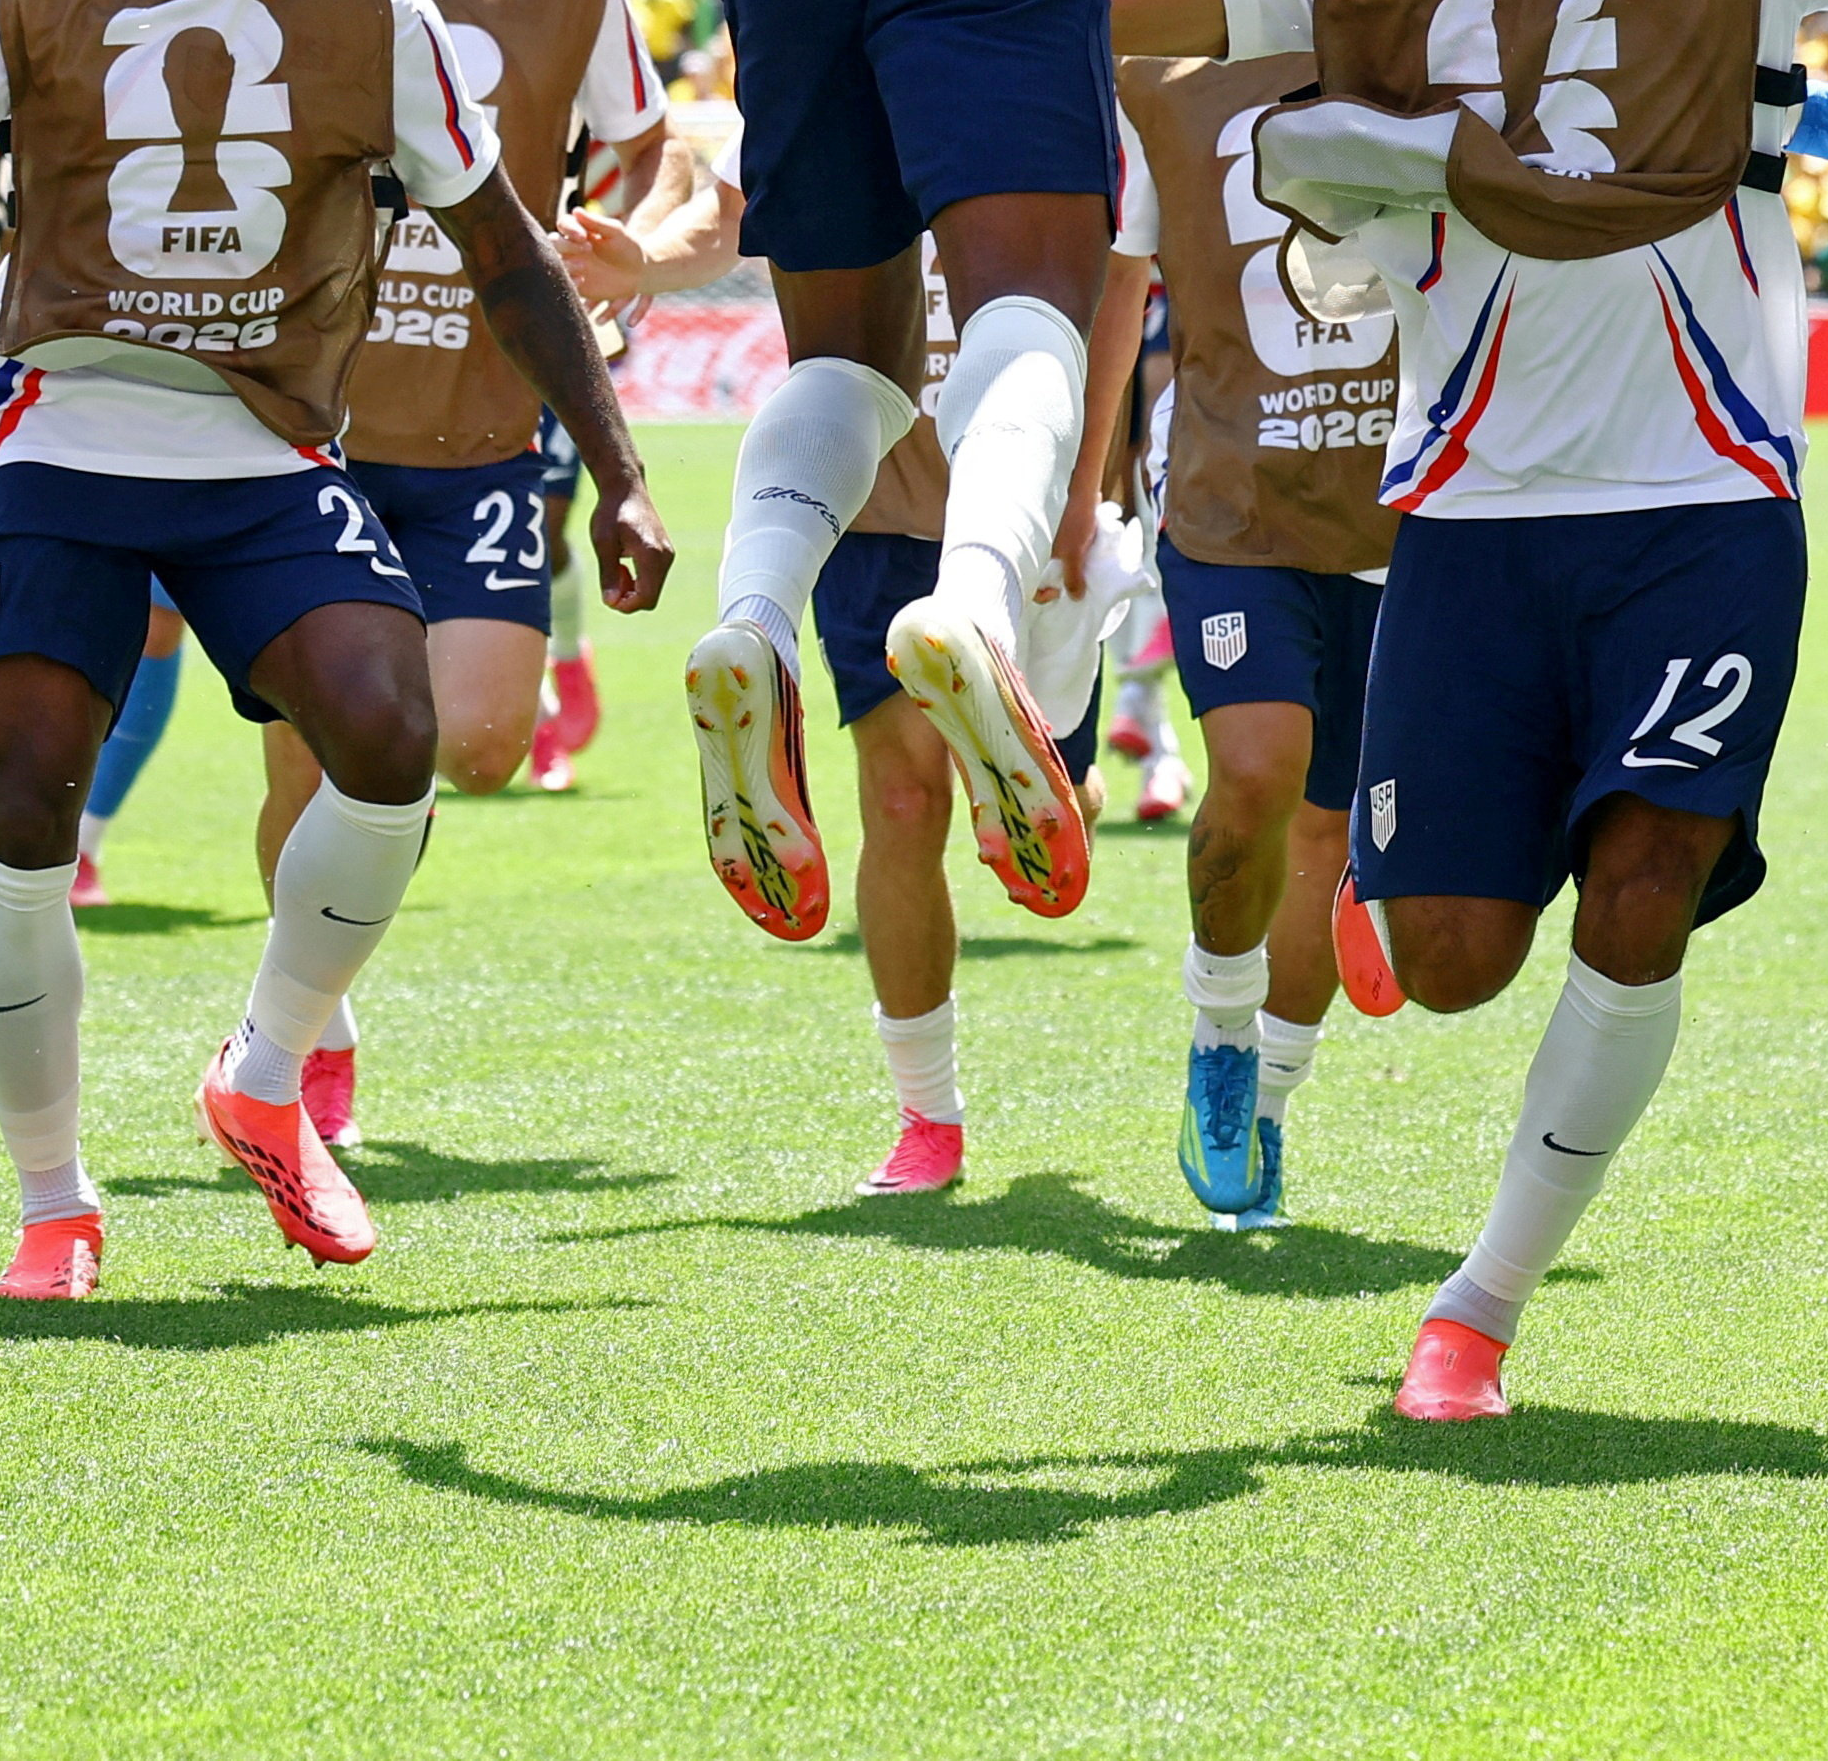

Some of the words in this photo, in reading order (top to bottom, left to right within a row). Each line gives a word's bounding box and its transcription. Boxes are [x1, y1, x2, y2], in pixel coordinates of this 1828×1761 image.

[161, 226, 242, 254] FIFA
[392, 223, 440, 250] IFA
[108, 290, 224, 317] WORLD
[229, 287, 285, 316] CUP
[423, 284, 475, 309] CUP
[366, 306, 471, 350] 026
[1341, 378, 1395, 404] CUP
[1257, 408, 1395, 452] 2026
[465, 490, 546, 570] 23
[1205, 615, 1242, 638] USA
[1629, 653, 1753, 757] 12
[1372, 783, 1393, 813] USA
